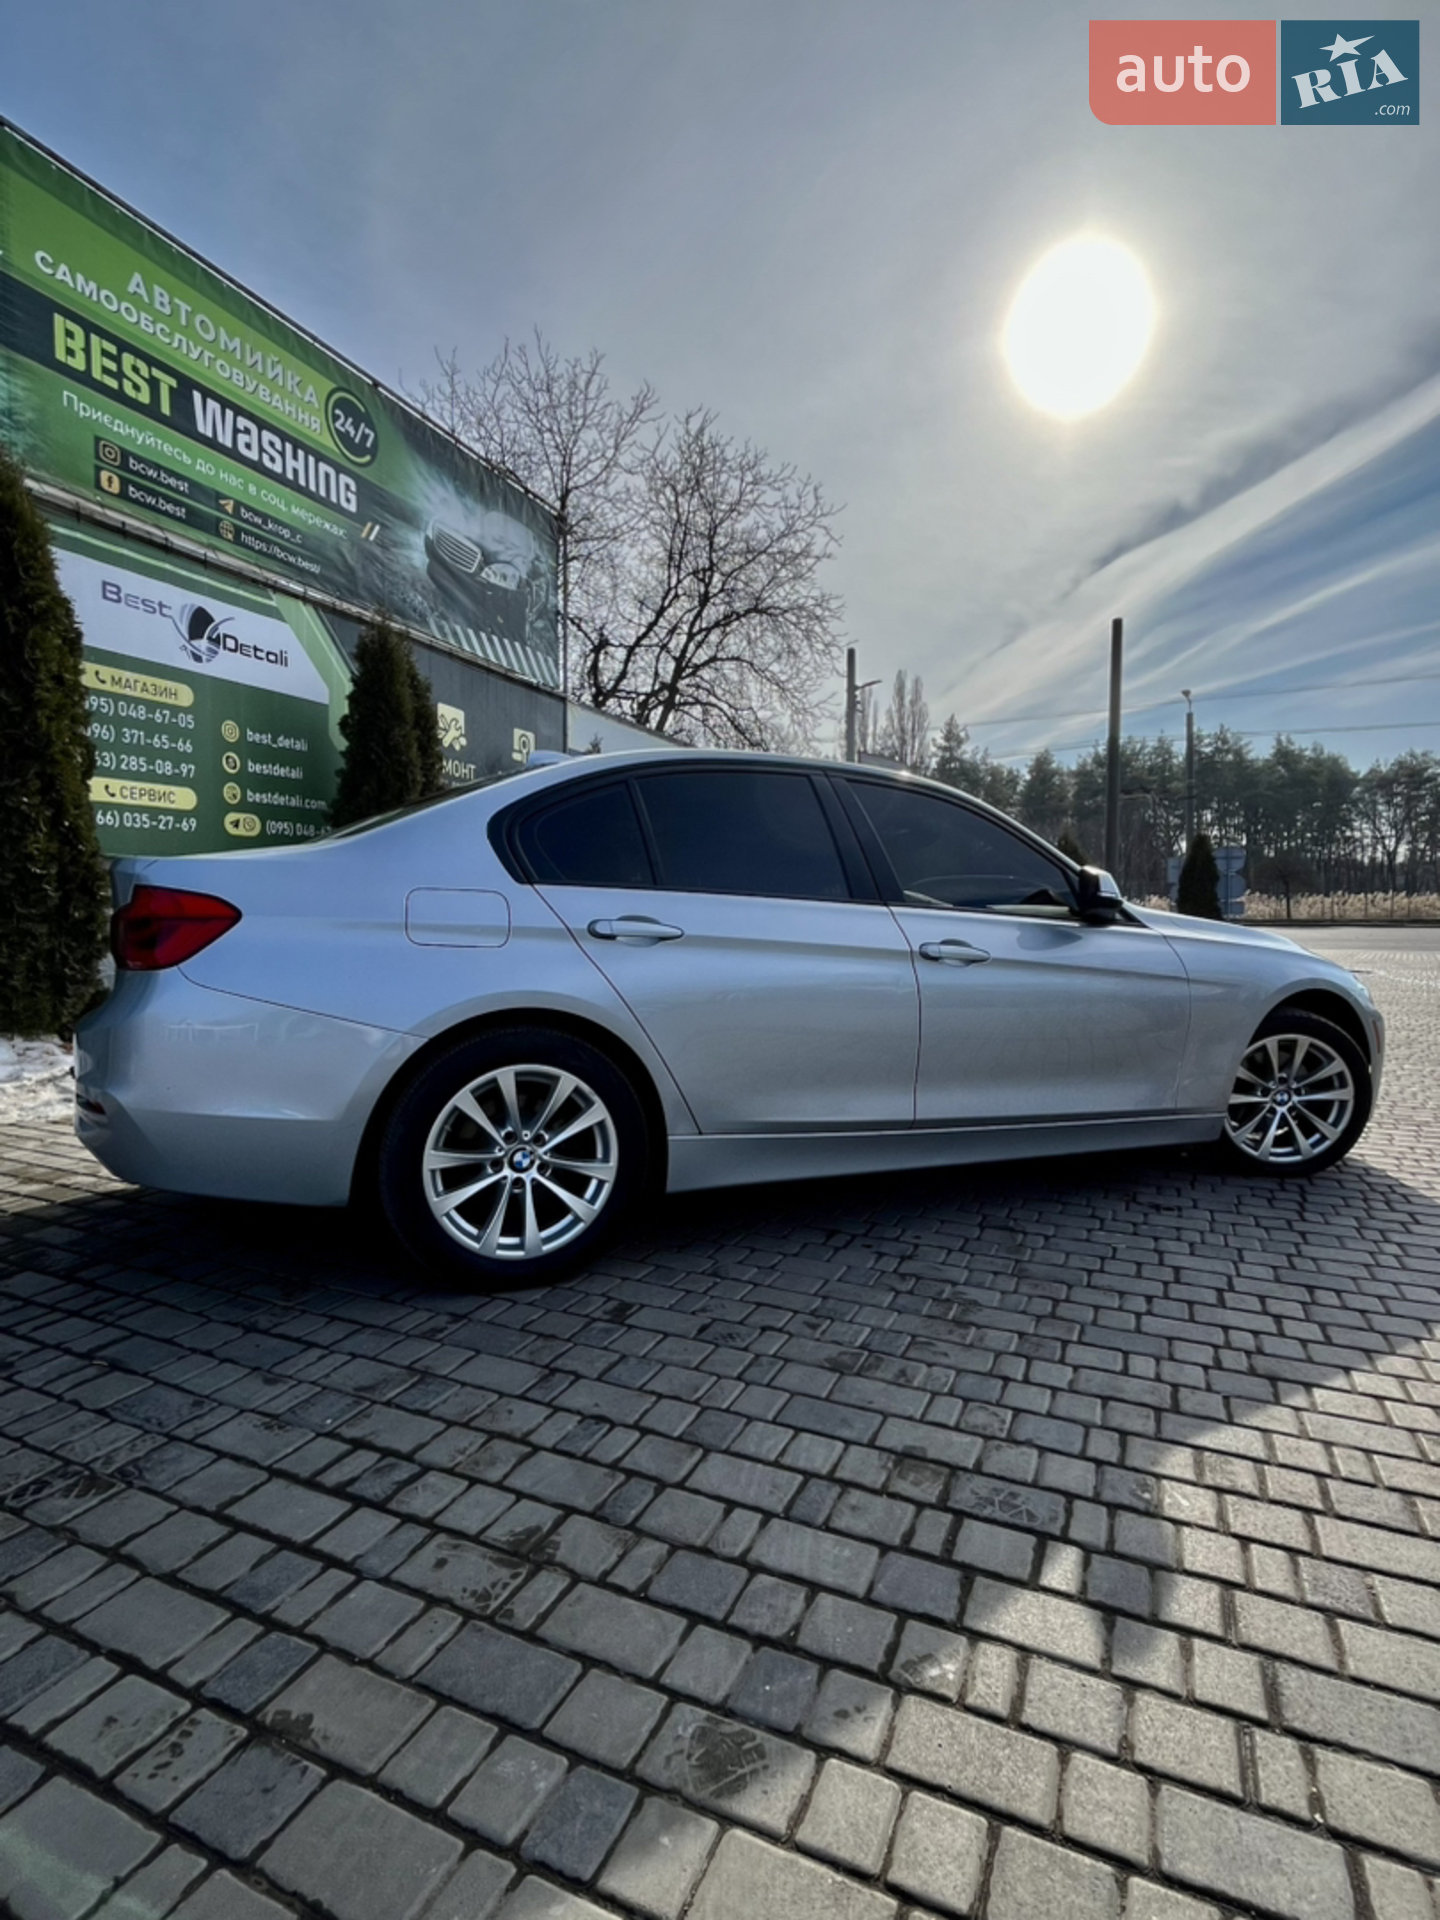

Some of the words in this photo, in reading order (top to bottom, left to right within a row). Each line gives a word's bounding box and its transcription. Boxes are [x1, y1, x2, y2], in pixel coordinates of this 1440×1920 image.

[34, 250, 321, 434] САМООБСЛУГОВУВАННЯ
[127, 271, 320, 410] АВТОМИЙКА
[54, 312, 178, 417] BEST
[333, 408, 375, 448] 24/7
[63, 389, 192, 465] Приєднуйтесь
[195, 458, 216, 476] до
[219, 469, 245, 490] нас
[248, 483, 257, 496] в
[290, 504, 348, 540] мережах
[128, 455, 190, 494] bcw.best
[127, 483, 187, 518] bcw.best
[110, 675, 179, 700] МАГАЗИН
[117, 700, 195, 730] 048-67-05
[121, 727, 194, 754] 371-65-66
[246, 727, 308, 752] best_detali
[120, 754, 196, 779] 285-08-97
[247, 758, 303, 780] bestdetali
[436, 757, 477, 780] МОНТ
[119, 785, 177, 805] СЕРВИС
[122, 811, 198, 832] 035-27-69
[265, 819, 294, 837] (095)
